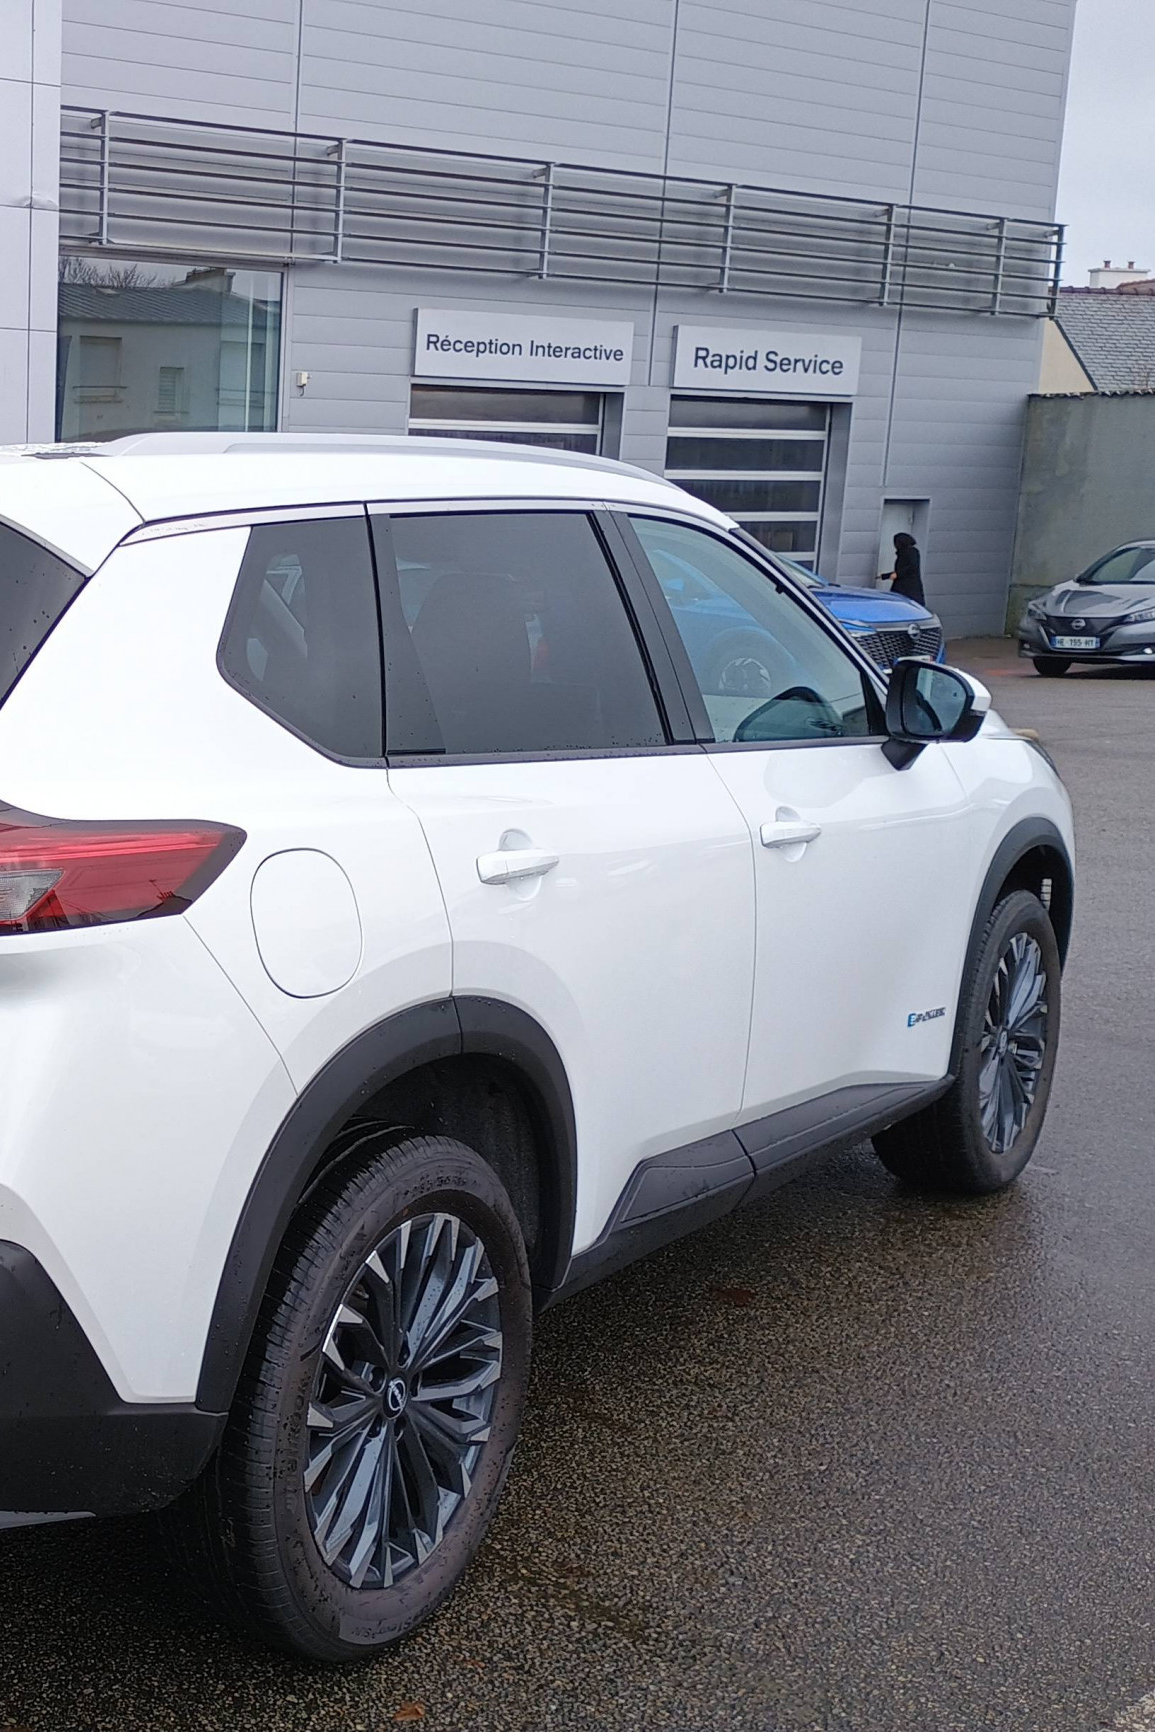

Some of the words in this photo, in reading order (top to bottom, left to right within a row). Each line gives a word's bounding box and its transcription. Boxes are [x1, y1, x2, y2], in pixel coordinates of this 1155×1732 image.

[426, 333, 523, 358] Réception
[529, 340, 624, 362] Interactive
[694, 346, 759, 375] Rapid
[763, 350, 845, 376] Service
